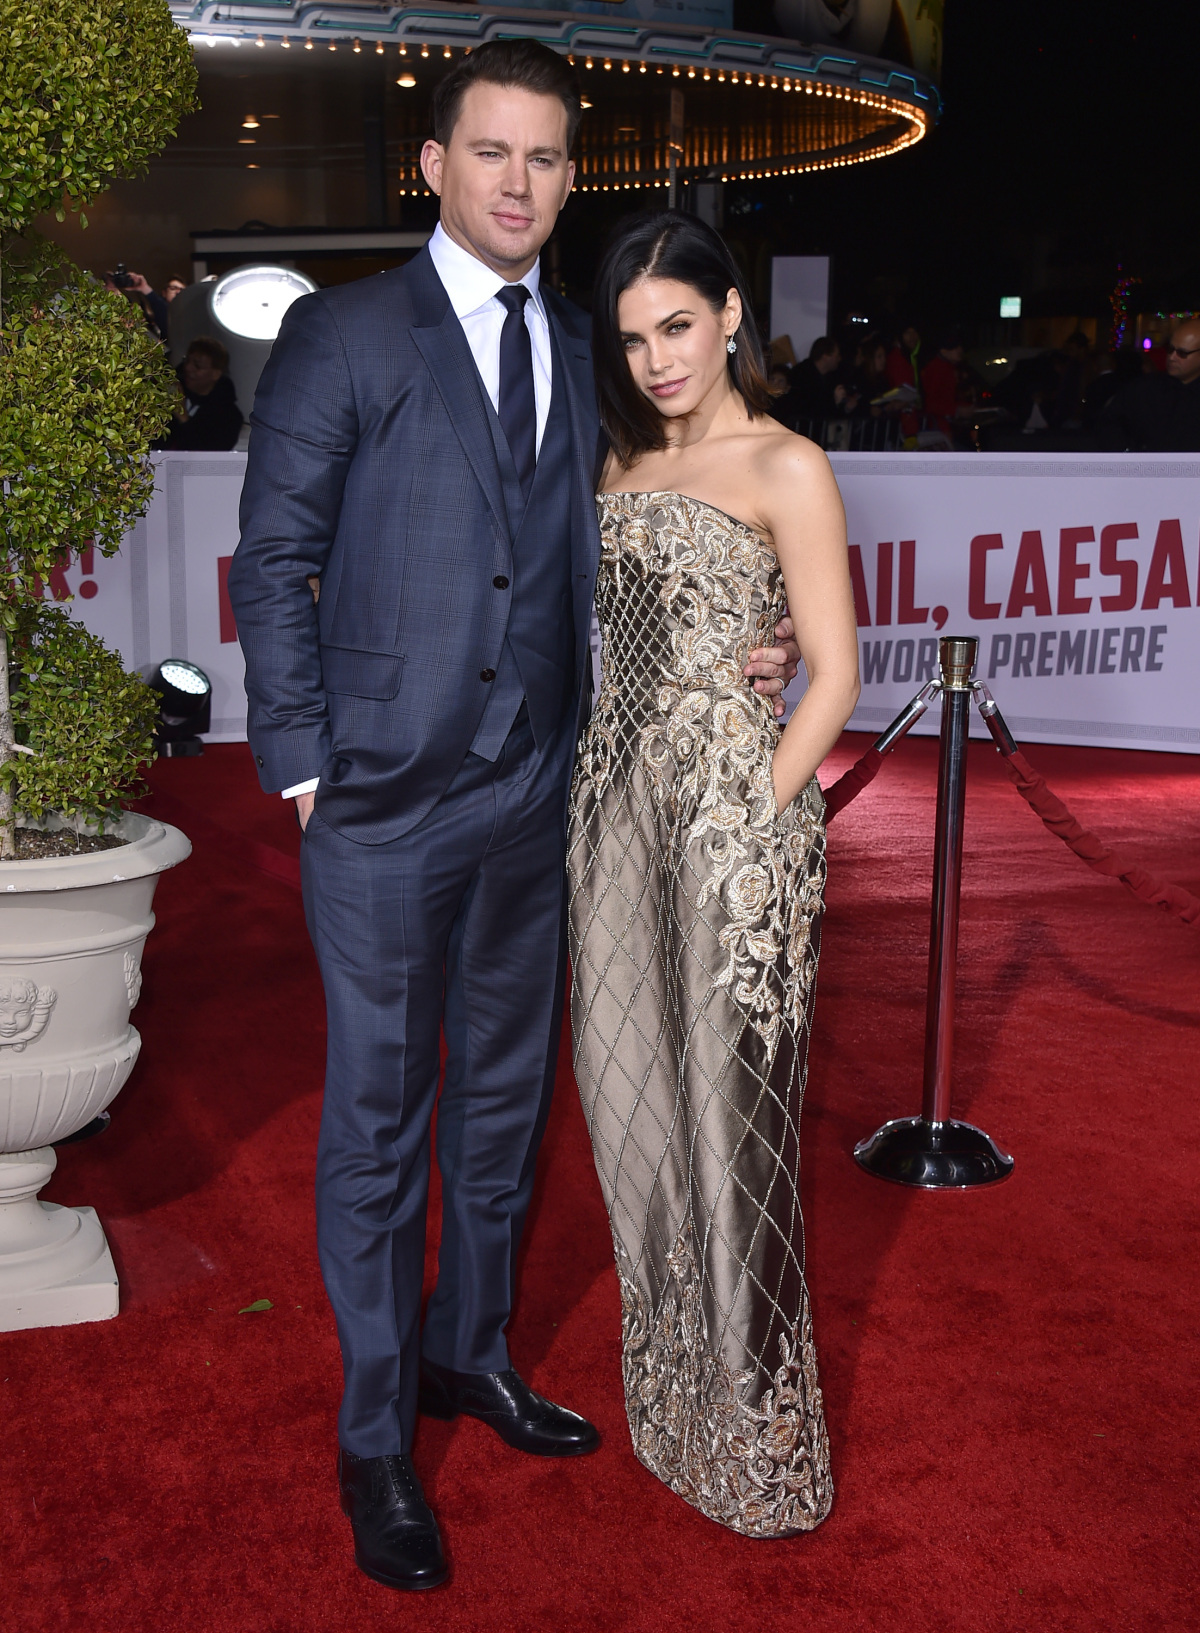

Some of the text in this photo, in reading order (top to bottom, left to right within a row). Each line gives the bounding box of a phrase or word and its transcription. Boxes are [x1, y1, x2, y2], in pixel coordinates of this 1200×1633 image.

[968, 519, 1200, 620] CAESA
[863, 625, 1167, 684] WOR PREMIERE
